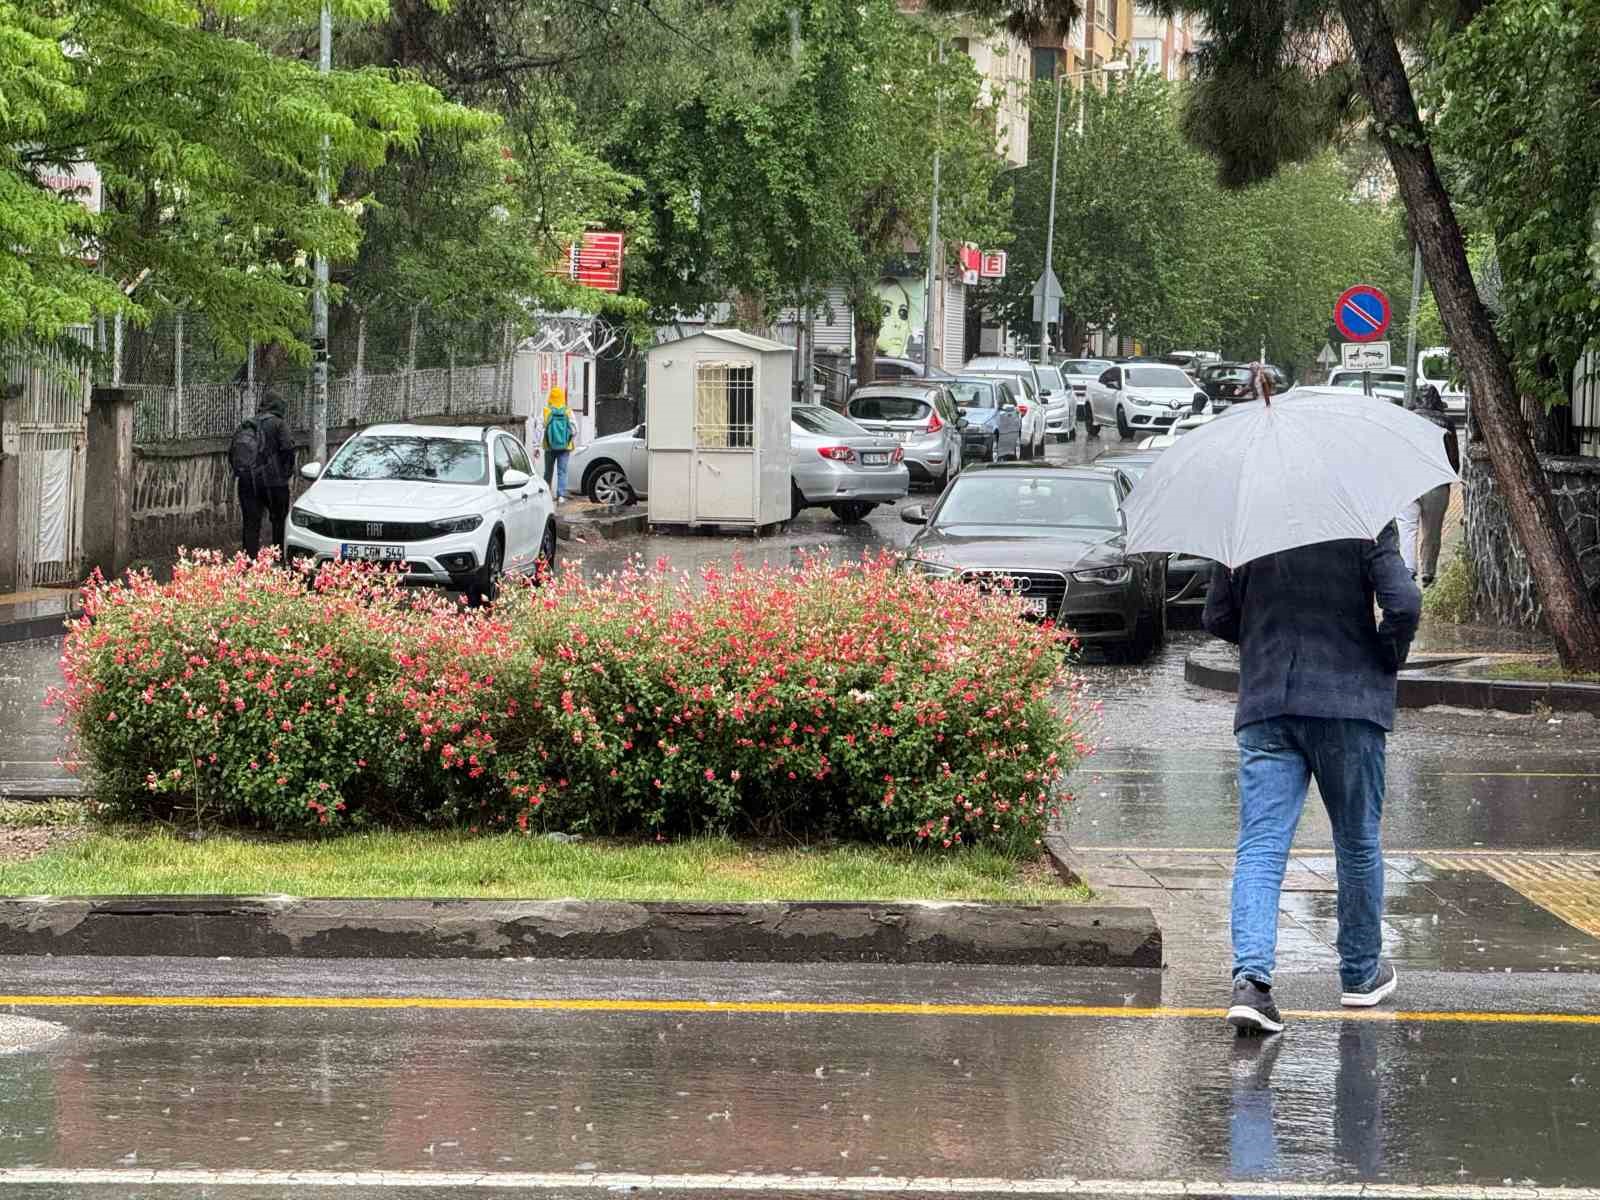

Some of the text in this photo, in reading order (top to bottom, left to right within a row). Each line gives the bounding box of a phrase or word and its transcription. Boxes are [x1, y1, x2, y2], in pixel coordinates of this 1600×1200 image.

[988, 256, 998, 271] E
[366, 523, 384, 536] FIAT
[349, 546, 359, 556] 35
[386, 547, 402, 558] 544
